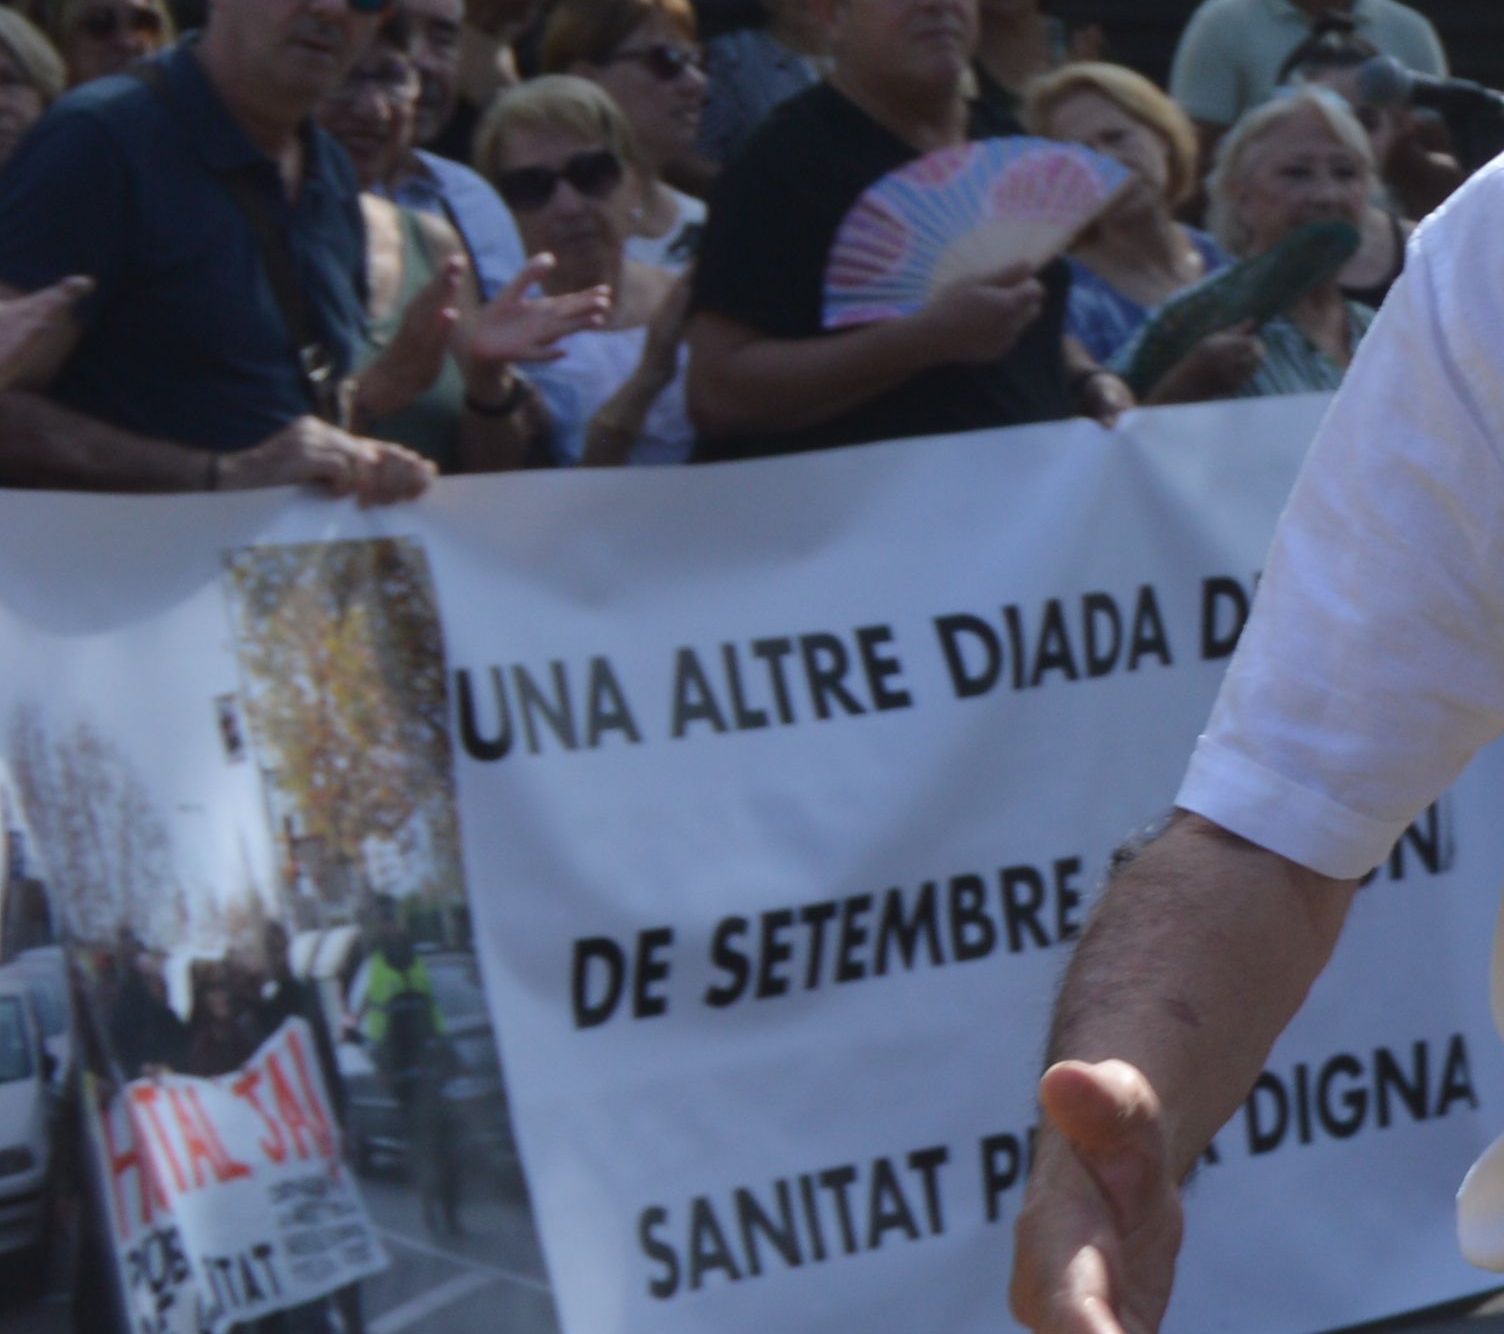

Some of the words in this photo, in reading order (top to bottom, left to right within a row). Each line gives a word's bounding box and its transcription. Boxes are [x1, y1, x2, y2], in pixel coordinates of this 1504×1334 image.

[456, 657, 641, 763] UNA
[669, 624, 914, 739] ALTRE
[934, 583, 1172, 701] DIADA
[1199, 572, 1262, 662] D
[571, 927, 673, 1030] DE
[703, 855, 1083, 1010] SETEMBRE
[637, 1144, 950, 1301] SANITAT
[1245, 1035, 1477, 1156] DIGNA
